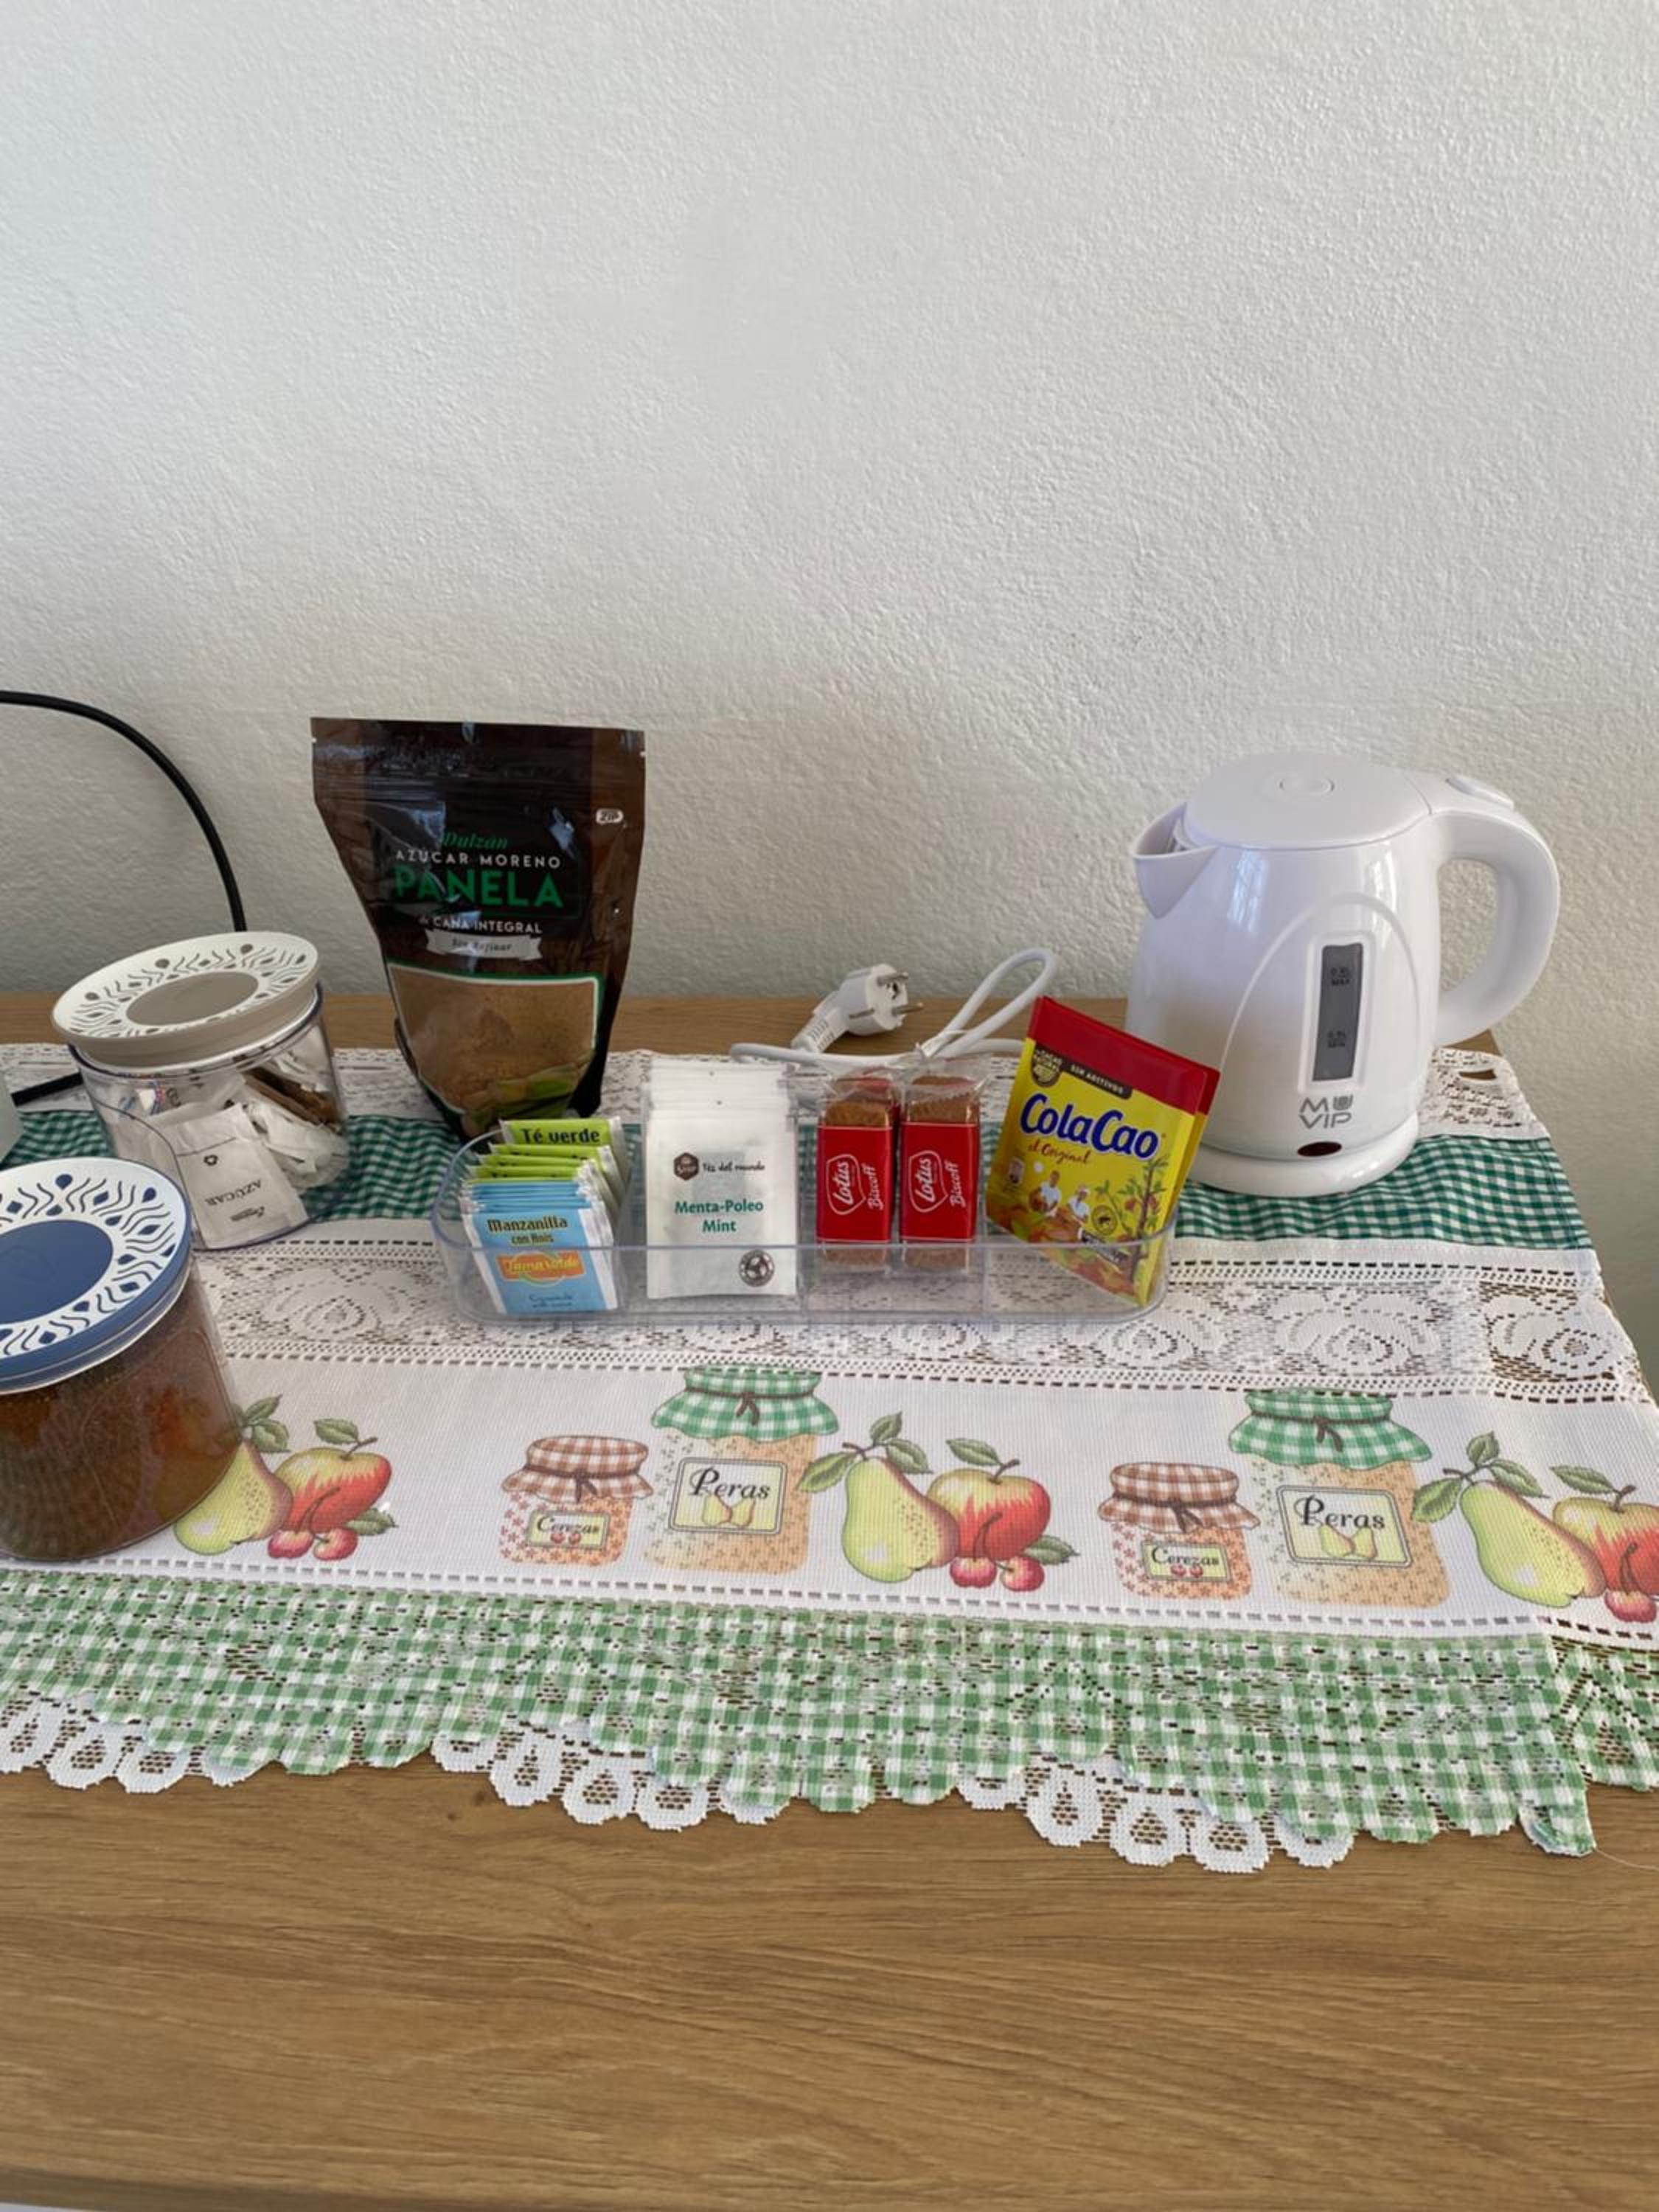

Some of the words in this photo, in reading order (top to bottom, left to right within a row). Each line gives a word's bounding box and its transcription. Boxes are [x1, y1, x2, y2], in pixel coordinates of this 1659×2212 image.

[479, 853, 561, 869] MORENO
[394, 864, 565, 908] PANELA
[473, 919, 543, 934] INTEGRAL
[521, 1128, 543, 1143] Té
[548, 1128, 600, 1143] verde
[1020, 1093, 1159, 1159] ColaCao
[832, 1161, 854, 1206] Lotus
[860, 1163, 884, 1211] Biscoff
[914, 1157, 936, 1203] Lotus
[943, 1159, 967, 1208] Biscoff
[674, 1199, 765, 1214] Menta-Poleo
[487, 1215, 568, 1234] Manzanilla
[702, 1219, 737, 1234] Mint
[689, 1467, 771, 1500] Peras
[536, 1515, 600, 1535] Cerezas
[1293, 1494, 1387, 1530] Peras
[1150, 1545, 1220, 1567] Cerezas
